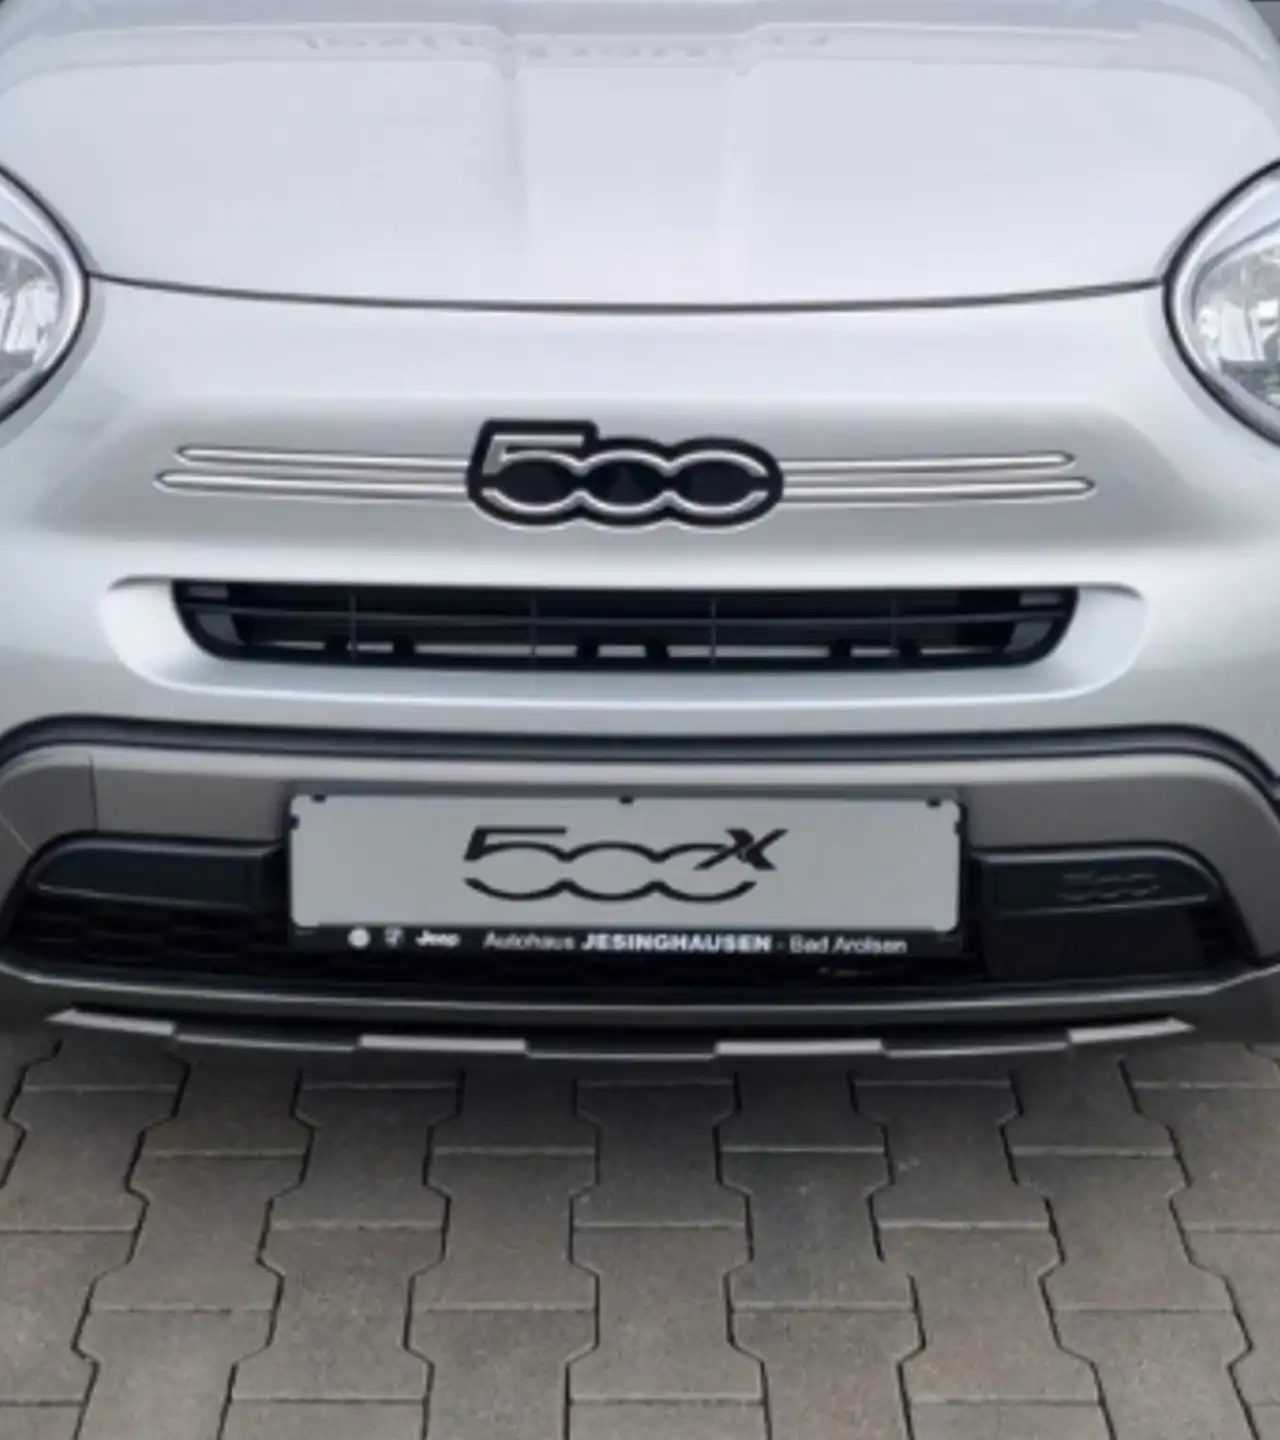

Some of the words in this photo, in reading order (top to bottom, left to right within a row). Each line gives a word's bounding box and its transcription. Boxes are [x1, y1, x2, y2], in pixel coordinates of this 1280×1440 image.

[474, 424, 778, 524] 500
[415, 930, 461, 949] Jeep
[483, 931, 576, 951] Autohaus
[581, 933, 772, 954] JESINGHAUSEN
[789, 935, 829, 954] Bad
[832, 936, 908, 955] Arolsen
